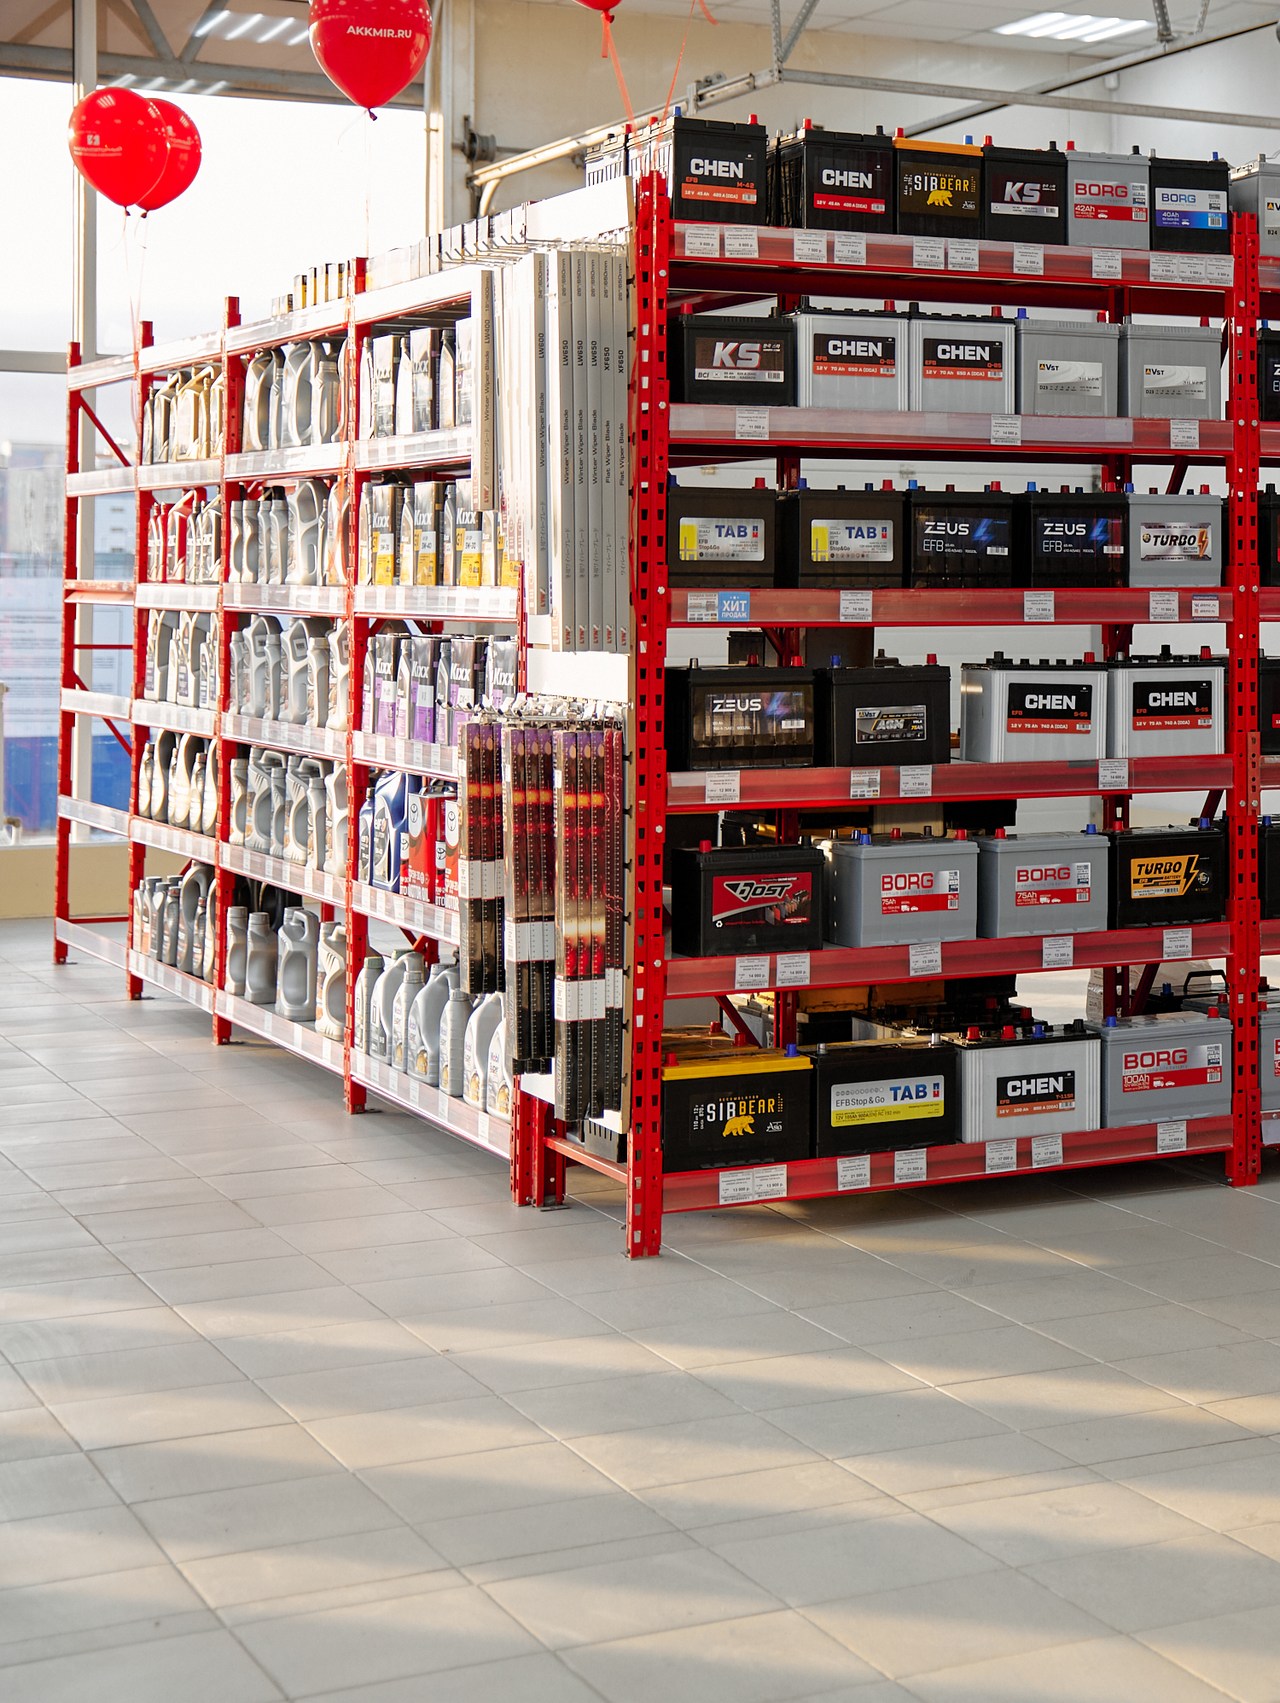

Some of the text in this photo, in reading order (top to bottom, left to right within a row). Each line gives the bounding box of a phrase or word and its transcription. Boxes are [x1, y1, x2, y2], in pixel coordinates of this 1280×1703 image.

[346, 25, 412, 39] AKKMIR.RU
[690, 158, 744, 179] CHEN
[822, 169, 873, 189] CHEN
[914, 175, 969, 192] SIBBEAR
[1004, 181, 1042, 204] KS
[1074, 182, 1129, 199] BORG
[1161, 192, 1197, 204] BORG
[1074, 203, 1096, 214] 42Ah
[1162, 211, 1180, 219] 40Ah
[713, 342, 762, 368] KS
[828, 340, 883, 357] CHEN
[937, 344, 990, 361] CHEN
[373, 512, 390, 528] Kixx
[414, 509, 433, 526] Kixx
[456, 508, 477, 525] Kixx
[715, 525, 748, 538] TAB
[845, 526, 877, 539] TAB
[924, 522, 970, 535] ZEUS
[1043, 523, 1087, 536] ZEUS
[923, 539, 944, 553] EFB
[1042, 540, 1063, 553] EFB
[1152, 533, 1198, 547] TURBO
[722, 600, 748, 612] ХИТ
[721, 611, 748, 619] ПРОДАЖ
[375, 657, 393, 674] Kixx
[412, 660, 429, 679] Kixx
[450, 662, 471, 682] Kixx
[494, 667, 515, 686] Kixx
[713, 699, 762, 713] ZEUS
[1025, 694, 1076, 710] CHEN
[1148, 692, 1197, 707] CHEN
[1017, 867, 1071, 882] BORG
[1136, 862, 1182, 876] TURBO
[881, 873, 934, 891] BORG
[1017, 891, 1038, 900] 75Ah
[1124, 1049, 1188, 1070] BORG
[1006, 1076, 1064, 1097] CHEN
[1123, 1073, 1150, 1084] 100Ah
[835, 1095, 885, 1107] EFB Stop & Go
[889, 1084, 928, 1102] TAB
[707, 1098, 775, 1122] SIBBEAR
